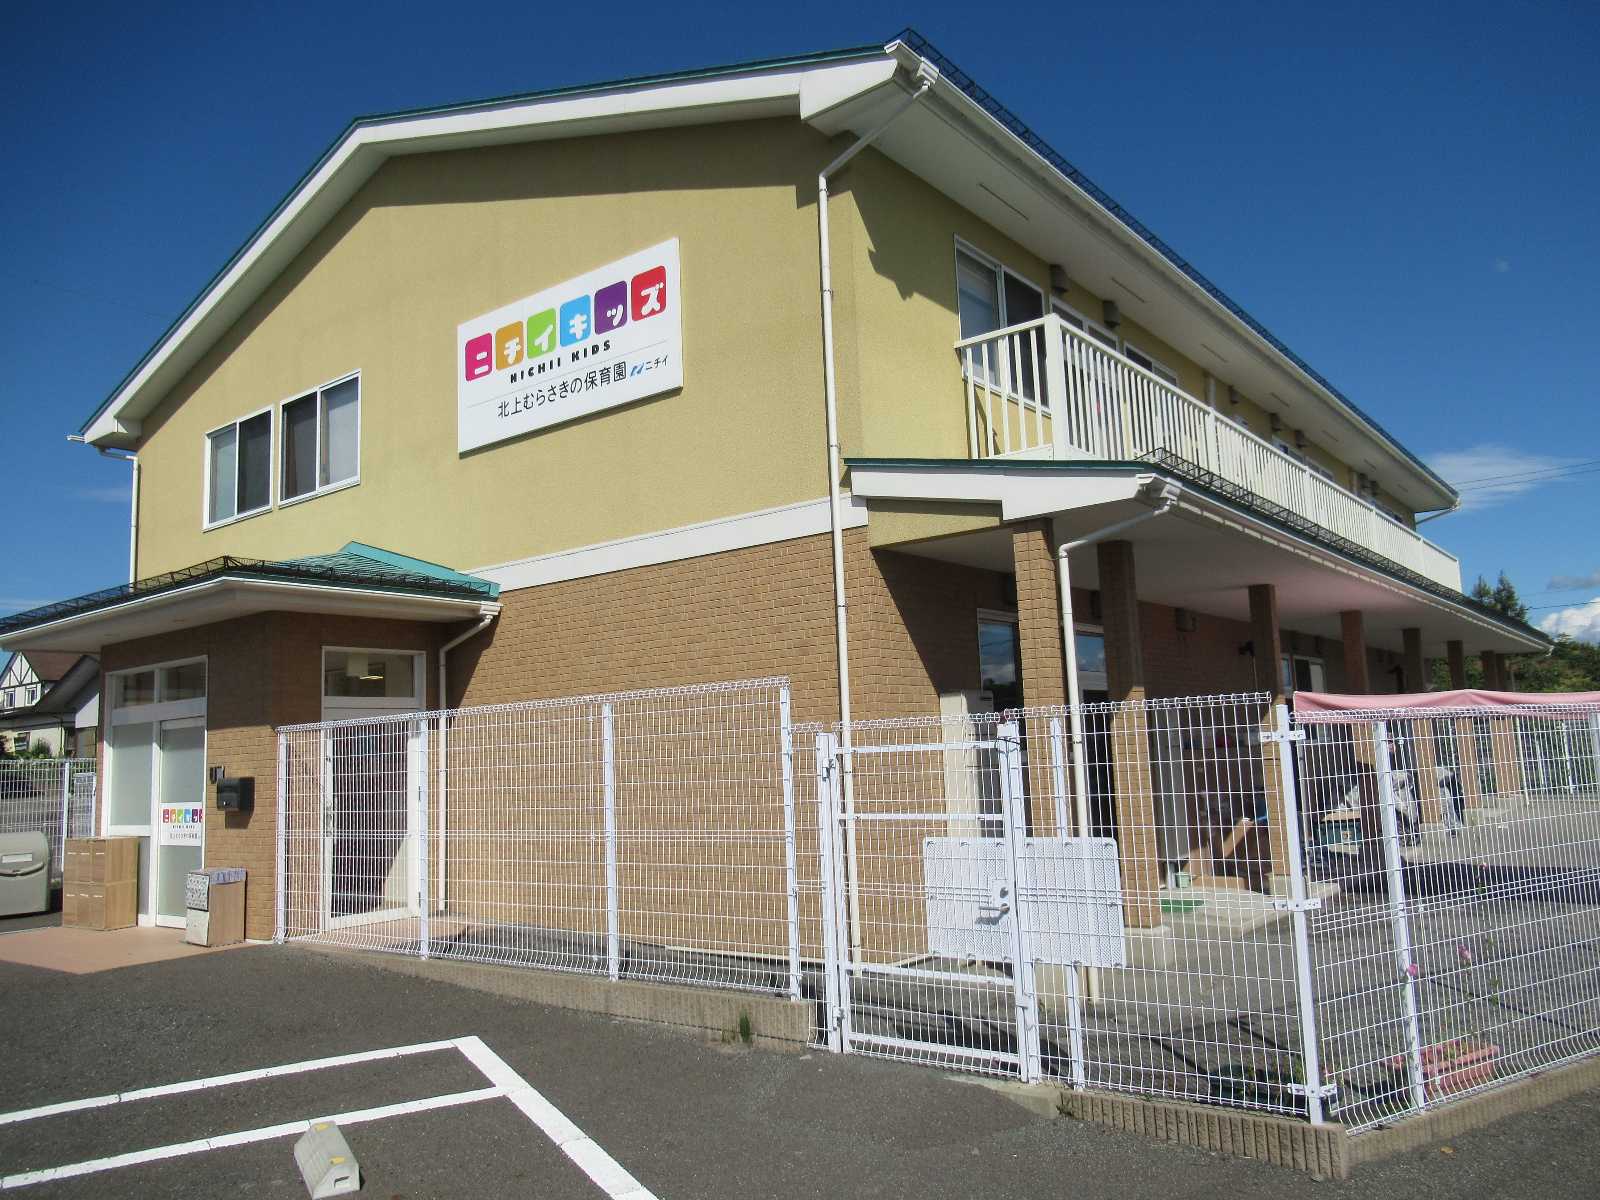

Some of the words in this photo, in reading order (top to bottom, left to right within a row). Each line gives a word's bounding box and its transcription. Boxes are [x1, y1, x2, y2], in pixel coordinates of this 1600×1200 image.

[470, 276, 665, 378] ニチイキッズ
[510, 357, 561, 383] NICHII
[572, 340, 611, 362] KIDS
[646, 353, 668, 370] ニチイ
[497, 361, 627, 418] 北上むらさきの保育園
